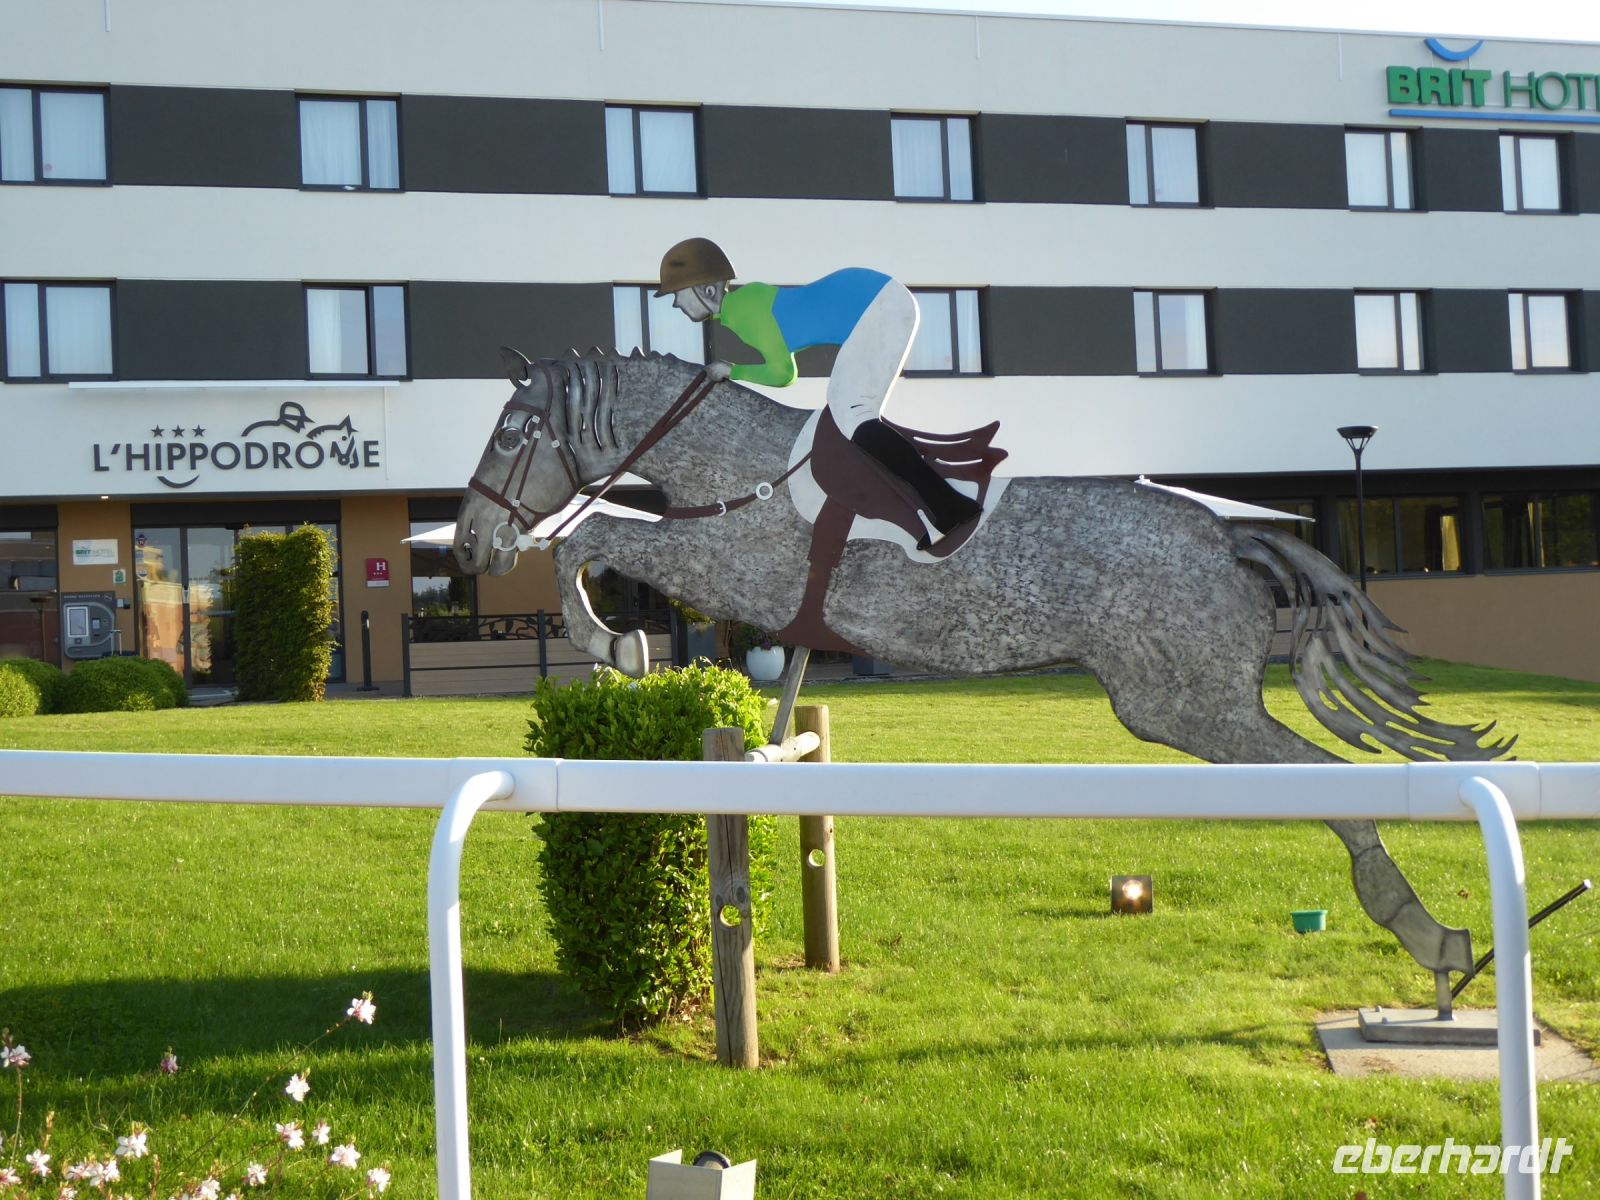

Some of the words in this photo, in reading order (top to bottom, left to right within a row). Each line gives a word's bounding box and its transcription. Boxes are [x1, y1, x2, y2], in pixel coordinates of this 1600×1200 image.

[1386, 65, 1491, 107] BRIT
[1503, 70, 1600, 112] HOT
[93, 440, 380, 472] L'HIPPODROME
[376, 562, 386, 571] H
